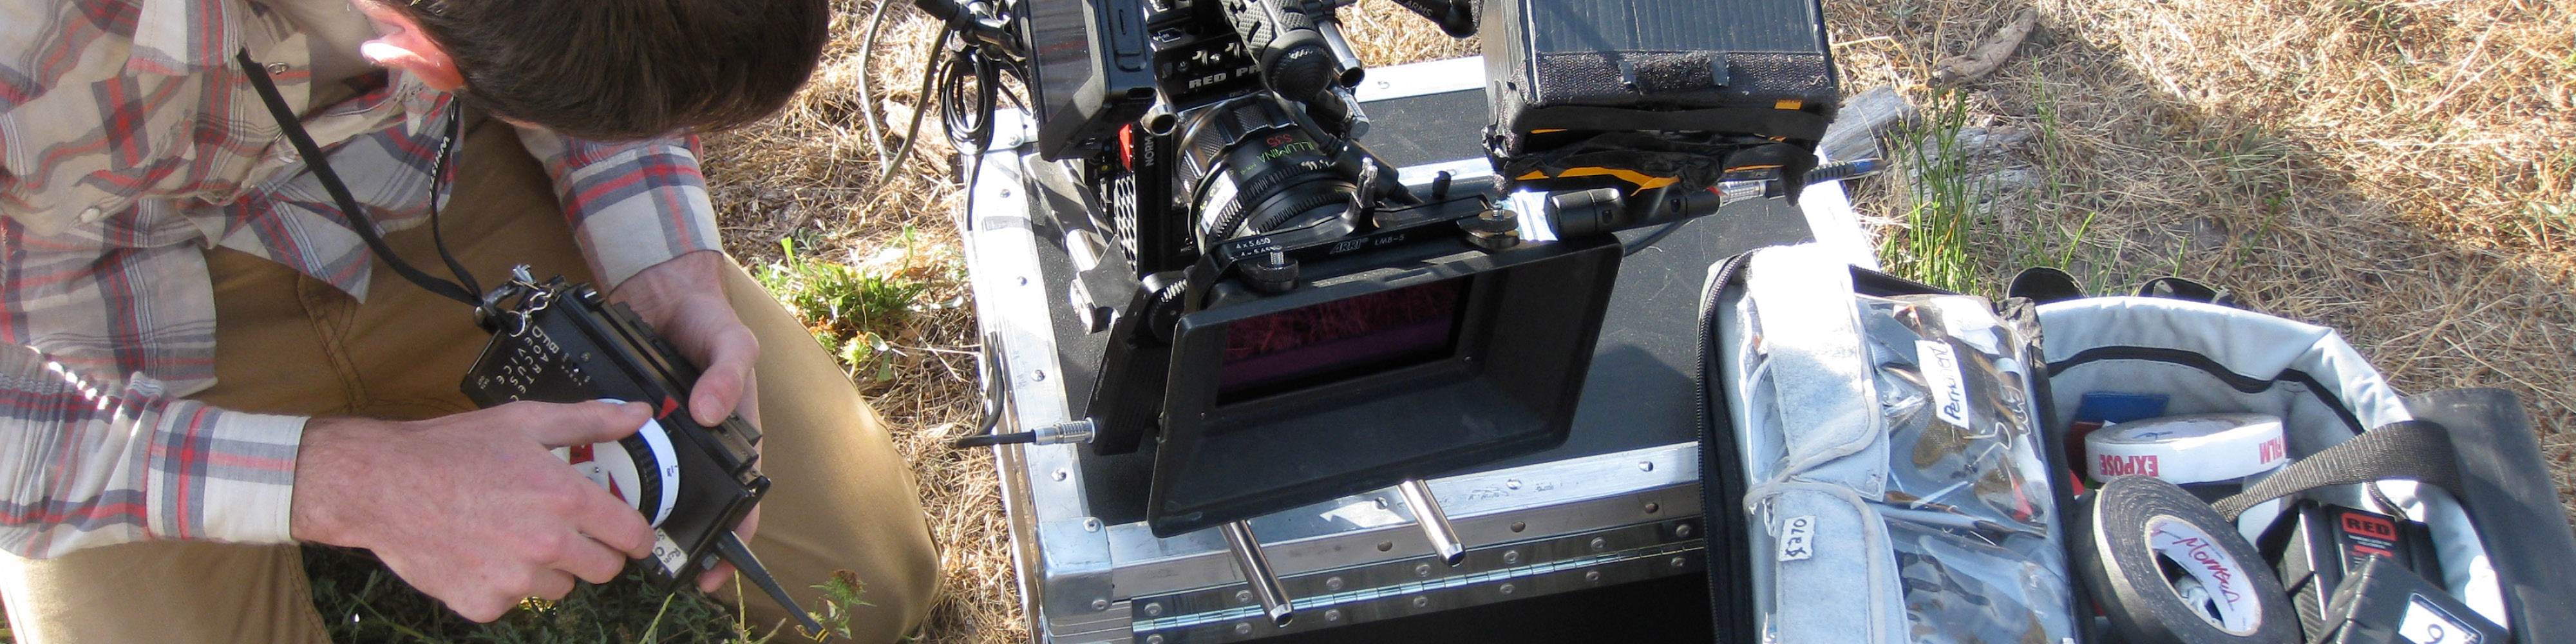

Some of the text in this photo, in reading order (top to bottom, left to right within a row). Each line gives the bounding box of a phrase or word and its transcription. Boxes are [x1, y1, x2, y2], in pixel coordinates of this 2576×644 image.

[1189, 72, 1227, 89] RED
[1256, 141, 1315, 163] ILLUMINA
[1329, 234, 1405, 254] ARRI LMB-5
[495, 325, 544, 384] DEVICE
[1927, 346, 1961, 420] Permanent
[2099, 454, 2158, 477] EXPOSE
[2347, 518, 2391, 536] RED
